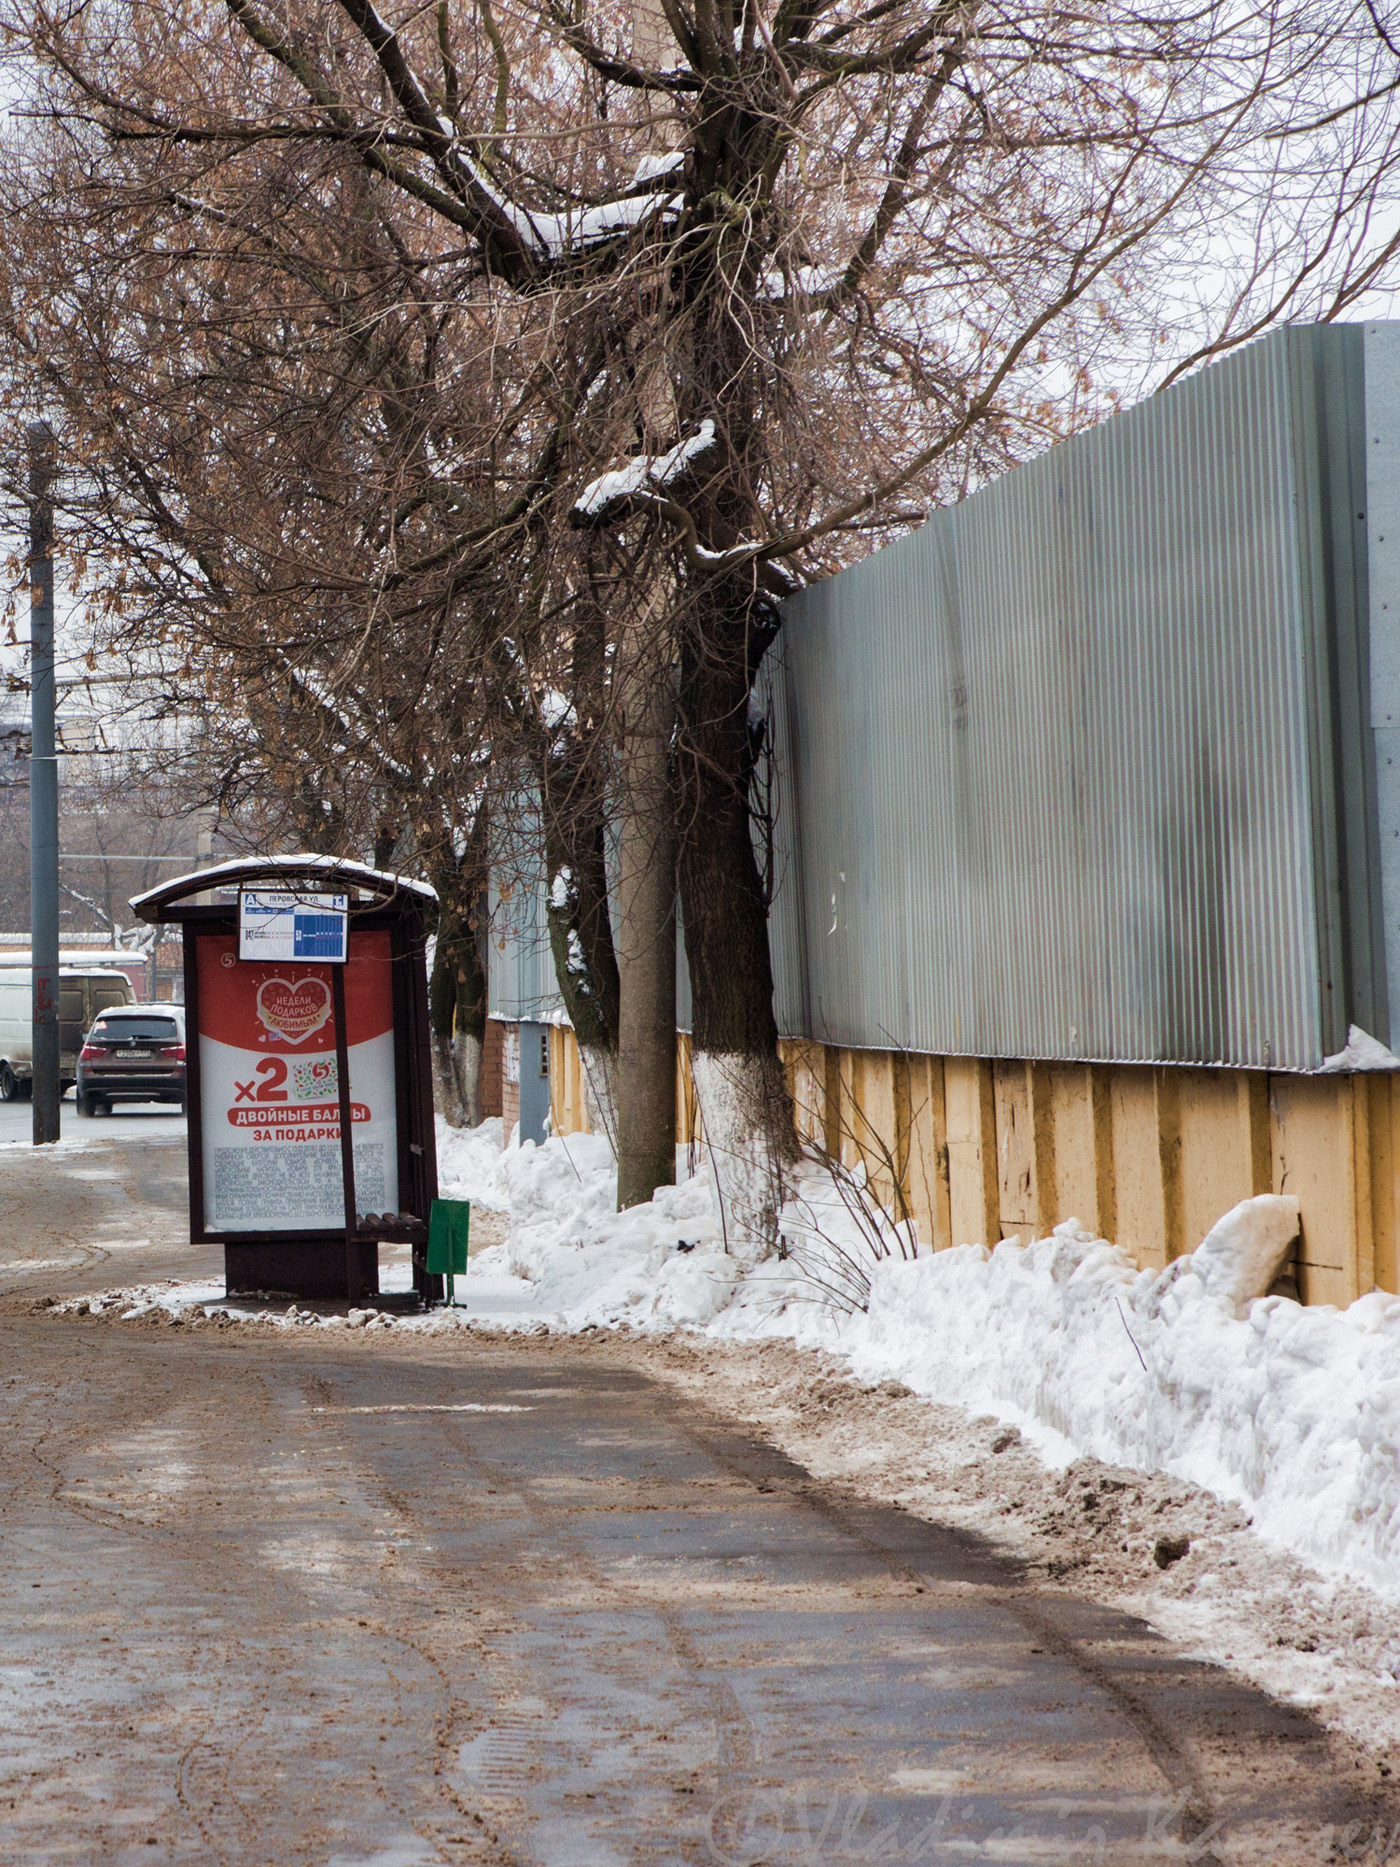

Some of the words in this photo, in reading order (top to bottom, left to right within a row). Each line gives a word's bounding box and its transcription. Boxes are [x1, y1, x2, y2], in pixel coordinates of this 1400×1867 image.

[276, 996, 312, 1007] НЕДЕЛИ
[270, 1003, 318, 1018] ПОДАРКОВ
[270, 1015, 319, 1029] ЛЮБИМЫМ
[236, 1108, 310, 1125] ДВОЙНЫЕ
[312, 1108, 366, 1121] БАЛЫ
[253, 1129, 273, 1142] ЗА
